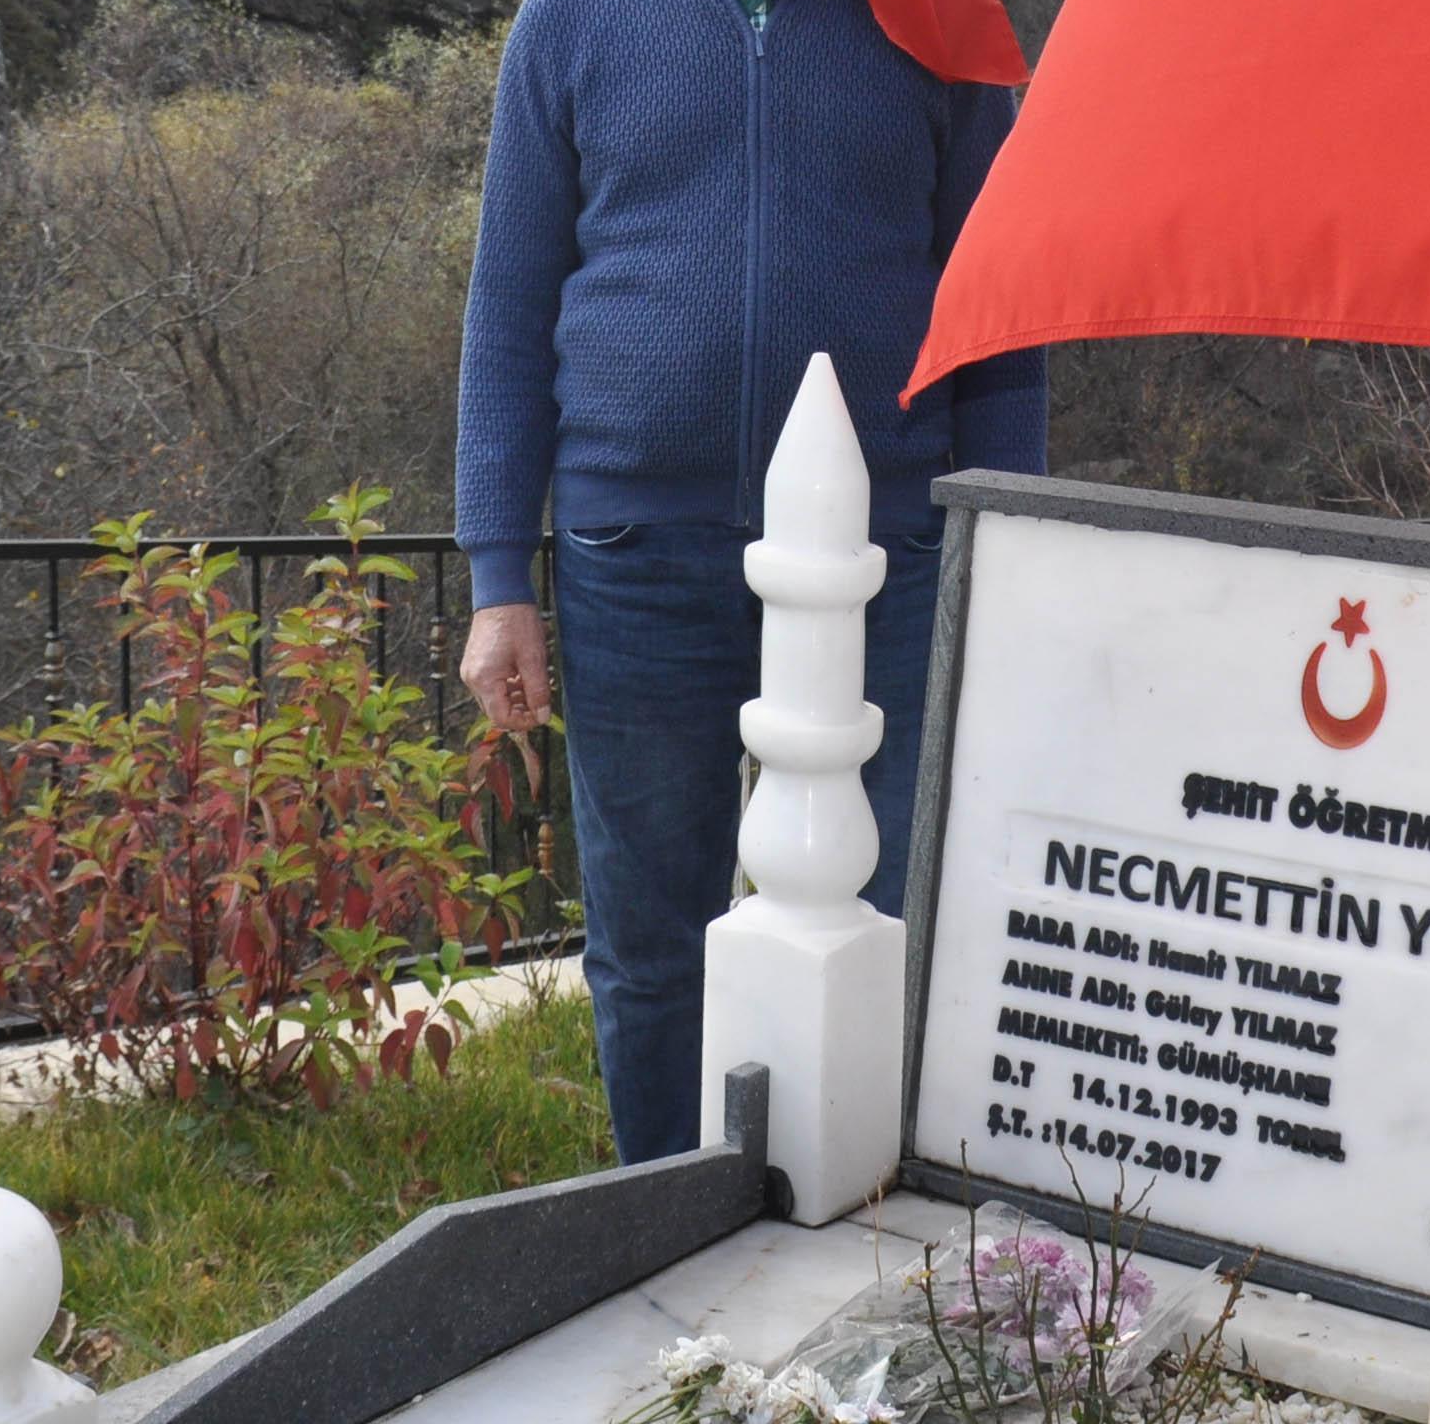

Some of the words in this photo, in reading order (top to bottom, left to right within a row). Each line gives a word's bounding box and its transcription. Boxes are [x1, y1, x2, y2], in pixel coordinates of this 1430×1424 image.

[1181, 772, 1279, 823] ŞEHİT
[1044, 840, 1380, 948] NECMETTİN
[1007, 909, 1076, 950] BABA
[1147, 939, 1228, 981] Hamit
[1234, 956, 1342, 1006] YILMAZ
[997, 1006, 1149, 1066] MEMLEKETİ:
[1001, 959, 1074, 999] ANNE
[1144, 989, 1223, 1037] Gülay
[1231, 1006, 1338, 1057] YILMAZ
[1072, 1073, 1238, 1137] 14.12.1993
